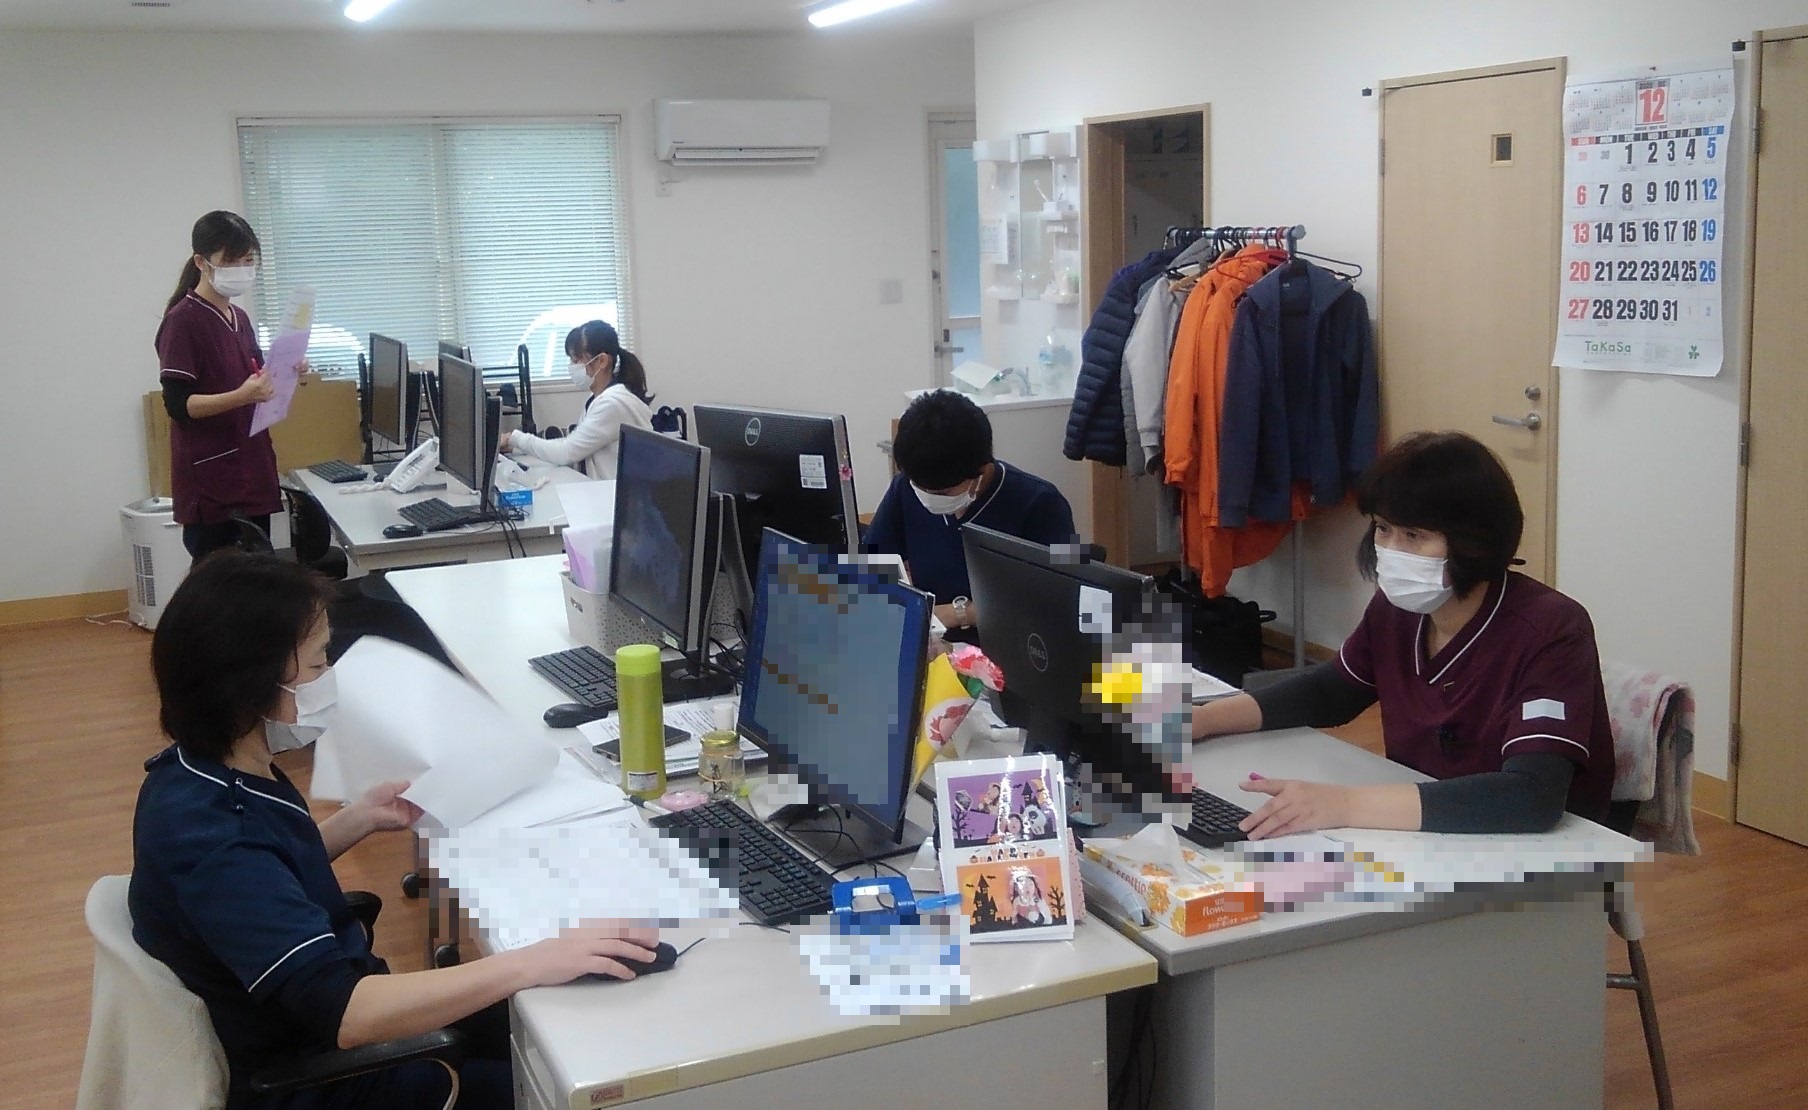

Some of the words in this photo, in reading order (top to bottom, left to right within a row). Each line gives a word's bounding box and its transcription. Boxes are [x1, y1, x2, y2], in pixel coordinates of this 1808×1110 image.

[1639, 87, 1666, 123] 12
[1625, 143, 1633, 164] 1
[1647, 142, 1658, 163] 2
[1667, 140, 1676, 161] 3
[1685, 139, 1696, 160] 4
[1706, 137, 1716, 158] 5
[1576, 185, 1586, 205] 6
[1599, 184, 1609, 205] 7
[1622, 183, 1632, 203] 8
[1646, 181, 1657, 202] 9
[1664, 180, 1680, 201] 10
[1684, 179, 1698, 201] 11
[1702, 178, 1717, 200] 12
[1572, 223, 1590, 243] 13
[1594, 222, 1613, 243] 14
[1619, 222, 1636, 243] 15
[1642, 221, 1659, 242] 16
[1664, 220, 1678, 242] 17
[1682, 219, 1697, 241] 18
[1701, 219, 1716, 241] 19
[1569, 261, 1590, 282] 20
[1594, 261, 1613, 281] 21
[1617, 261, 1637, 281] 22
[1640, 261, 1659, 281] 23
[1662, 260, 1679, 281] 24
[1681, 260, 1697, 282] 25
[1699, 260, 1716, 282] 26
[1568, 299, 1589, 320] 27
[1592, 299, 1613, 319] 28
[1616, 299, 1637, 320] 29
[1640, 299, 1658, 321] 30
[1662, 300, 1678, 321] 31
[1585, 341, 1631, 353] TaKaSa
